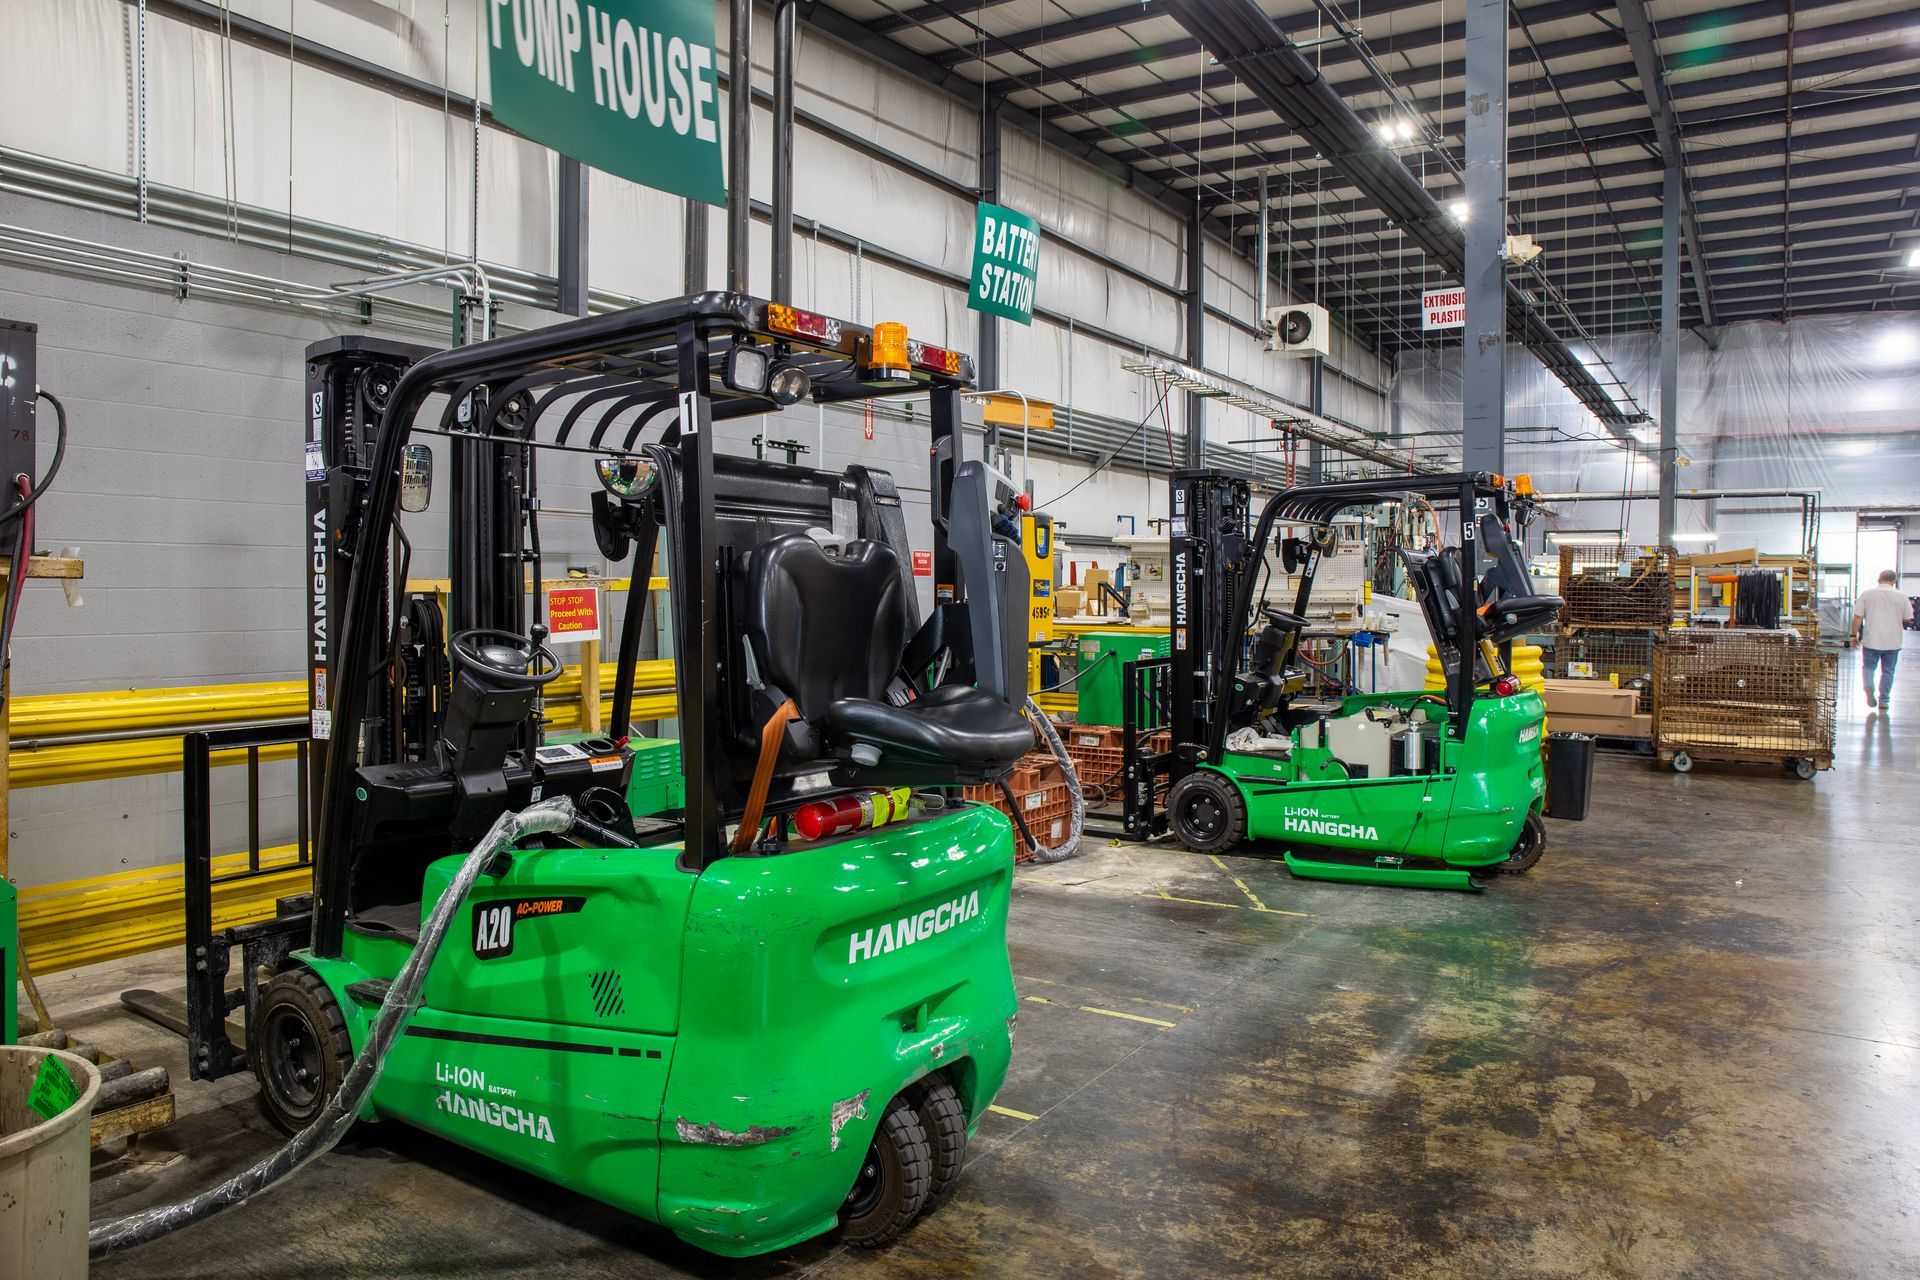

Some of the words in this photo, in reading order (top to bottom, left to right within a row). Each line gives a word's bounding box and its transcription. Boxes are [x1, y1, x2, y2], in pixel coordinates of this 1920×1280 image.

[587, 4, 718, 143] HOUSE
[979, 262, 1035, 314] STATION
[684, 393, 694, 432] 1
[1465, 523, 1473, 539] 5
[313, 507, 327, 661] HANGCHA
[550, 597, 566, 606] STOP
[567, 596, 584, 605] STOP
[1175, 552, 1187, 625] HANGCHA
[550, 608, 576, 618] Proceed
[577, 607, 594, 617] With
[558, 621, 583, 630] Caution
[1284, 806, 1319, 818] Li-ION
[1284, 817, 1379, 841] HANGCHA
[516, 899, 563, 915] AC-POWER
[475, 905, 512, 951] A20
[848, 889, 979, 965] HANGCHA
[436, 1061, 485, 1091] Li-ION
[488, 1084, 517, 1098] BATTERY
[436, 1089, 556, 1143] HANGCHA
